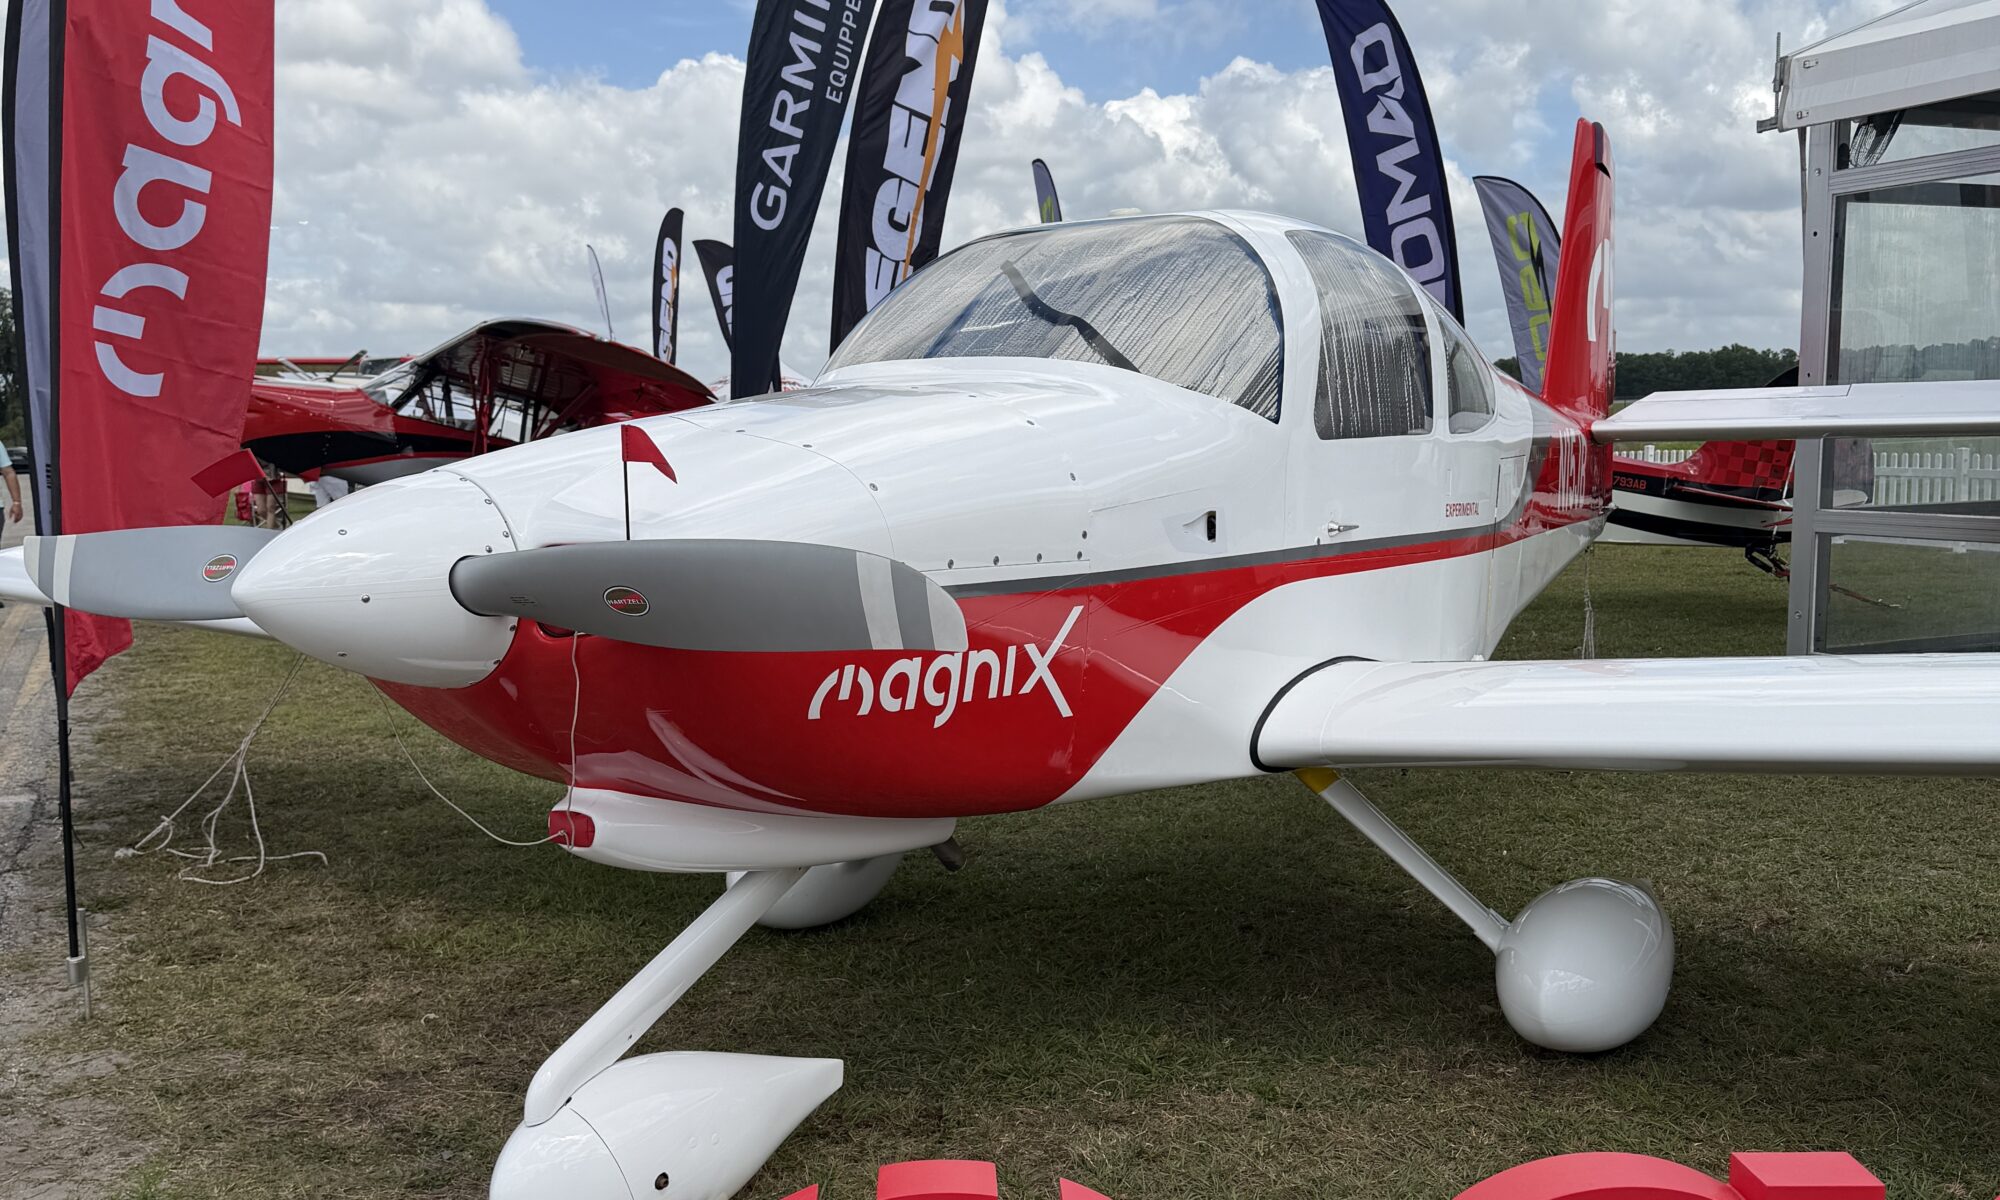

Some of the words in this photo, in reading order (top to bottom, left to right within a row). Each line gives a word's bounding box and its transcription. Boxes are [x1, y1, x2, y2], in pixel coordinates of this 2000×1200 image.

[1350, 22, 1446, 307] OMAD
[1445, 502, 1480, 518] EXPERIMENTAL
[807, 605, 1084, 729] magniX
